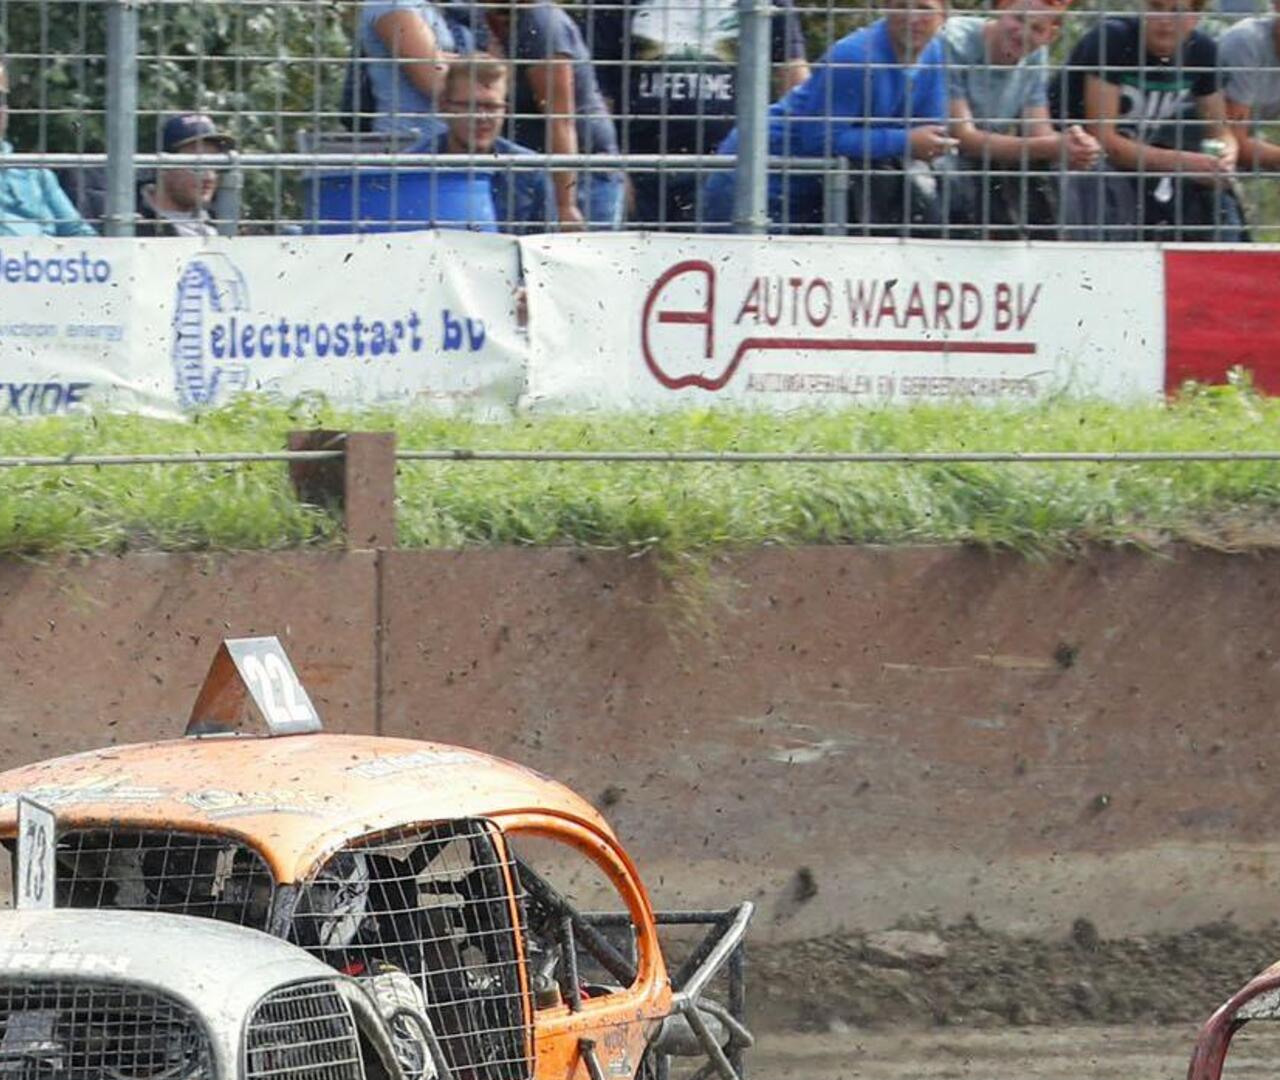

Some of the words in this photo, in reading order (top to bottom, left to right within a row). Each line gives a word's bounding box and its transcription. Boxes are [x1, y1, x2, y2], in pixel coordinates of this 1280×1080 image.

[735, 277, 831, 327] AUTO
[848, 280, 983, 331] WAARD
[993, 283, 1043, 332] BV
[211, 310, 421, 359] electrostart
[442, 309, 486, 351] bv
[243, 653, 312, 723] 22
